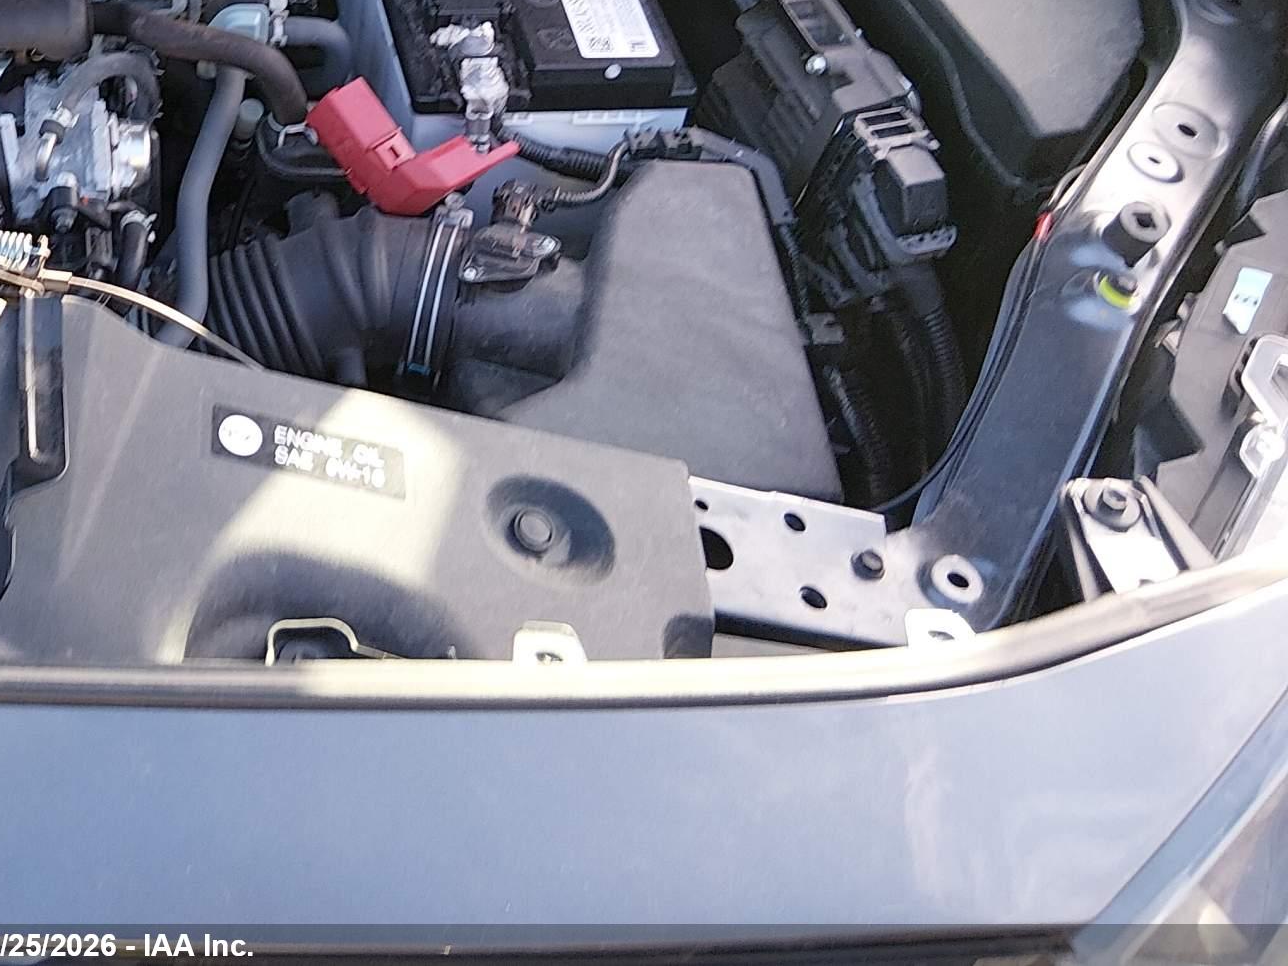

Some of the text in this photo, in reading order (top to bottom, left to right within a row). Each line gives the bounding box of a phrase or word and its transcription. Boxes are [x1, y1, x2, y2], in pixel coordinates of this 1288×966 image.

[274, 424, 343, 458] ENGINE
[353, 443, 385, 469] OIL
[274, 445, 314, 472] SAE
